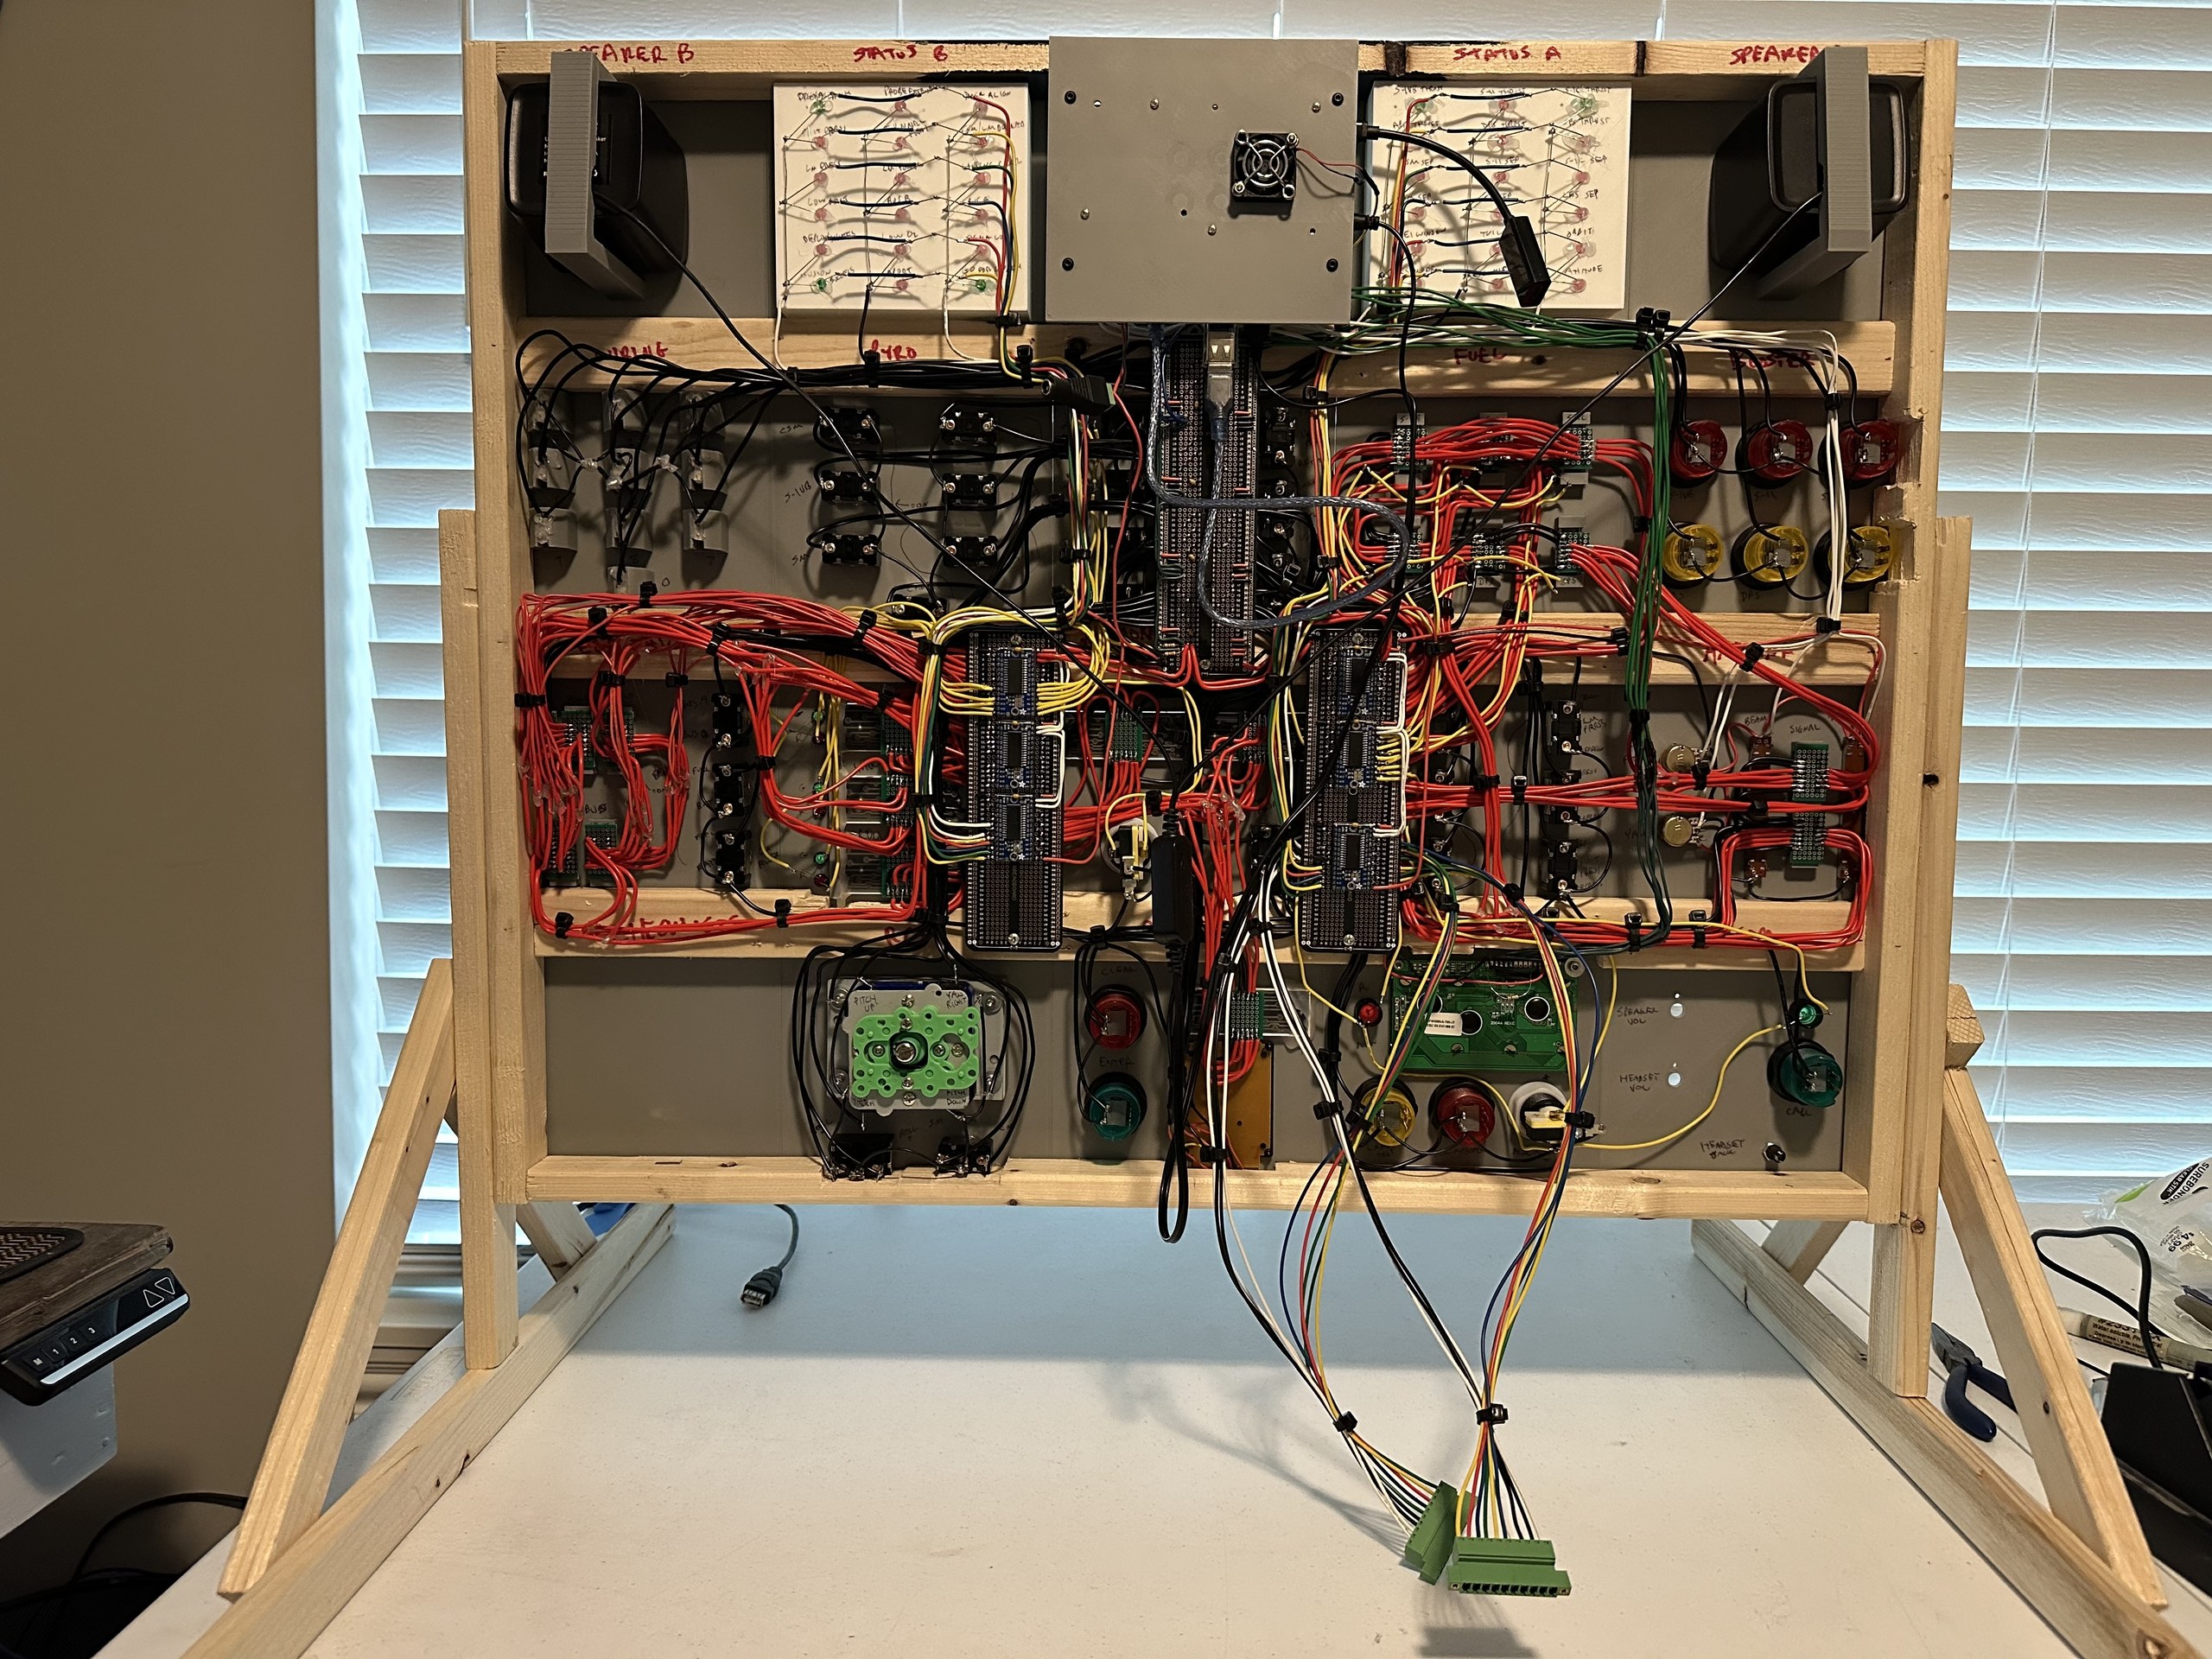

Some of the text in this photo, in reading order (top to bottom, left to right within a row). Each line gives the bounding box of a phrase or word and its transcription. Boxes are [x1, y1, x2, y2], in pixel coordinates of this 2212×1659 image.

[678, 43, 694, 64] B
[1453, 45, 1561, 61] STATUS A
[1453, 346, 1507, 365] FUEL
[2162, 1161, 2209, 1205] SUREBONDER
[70, 1336, 78, 1344] 2
